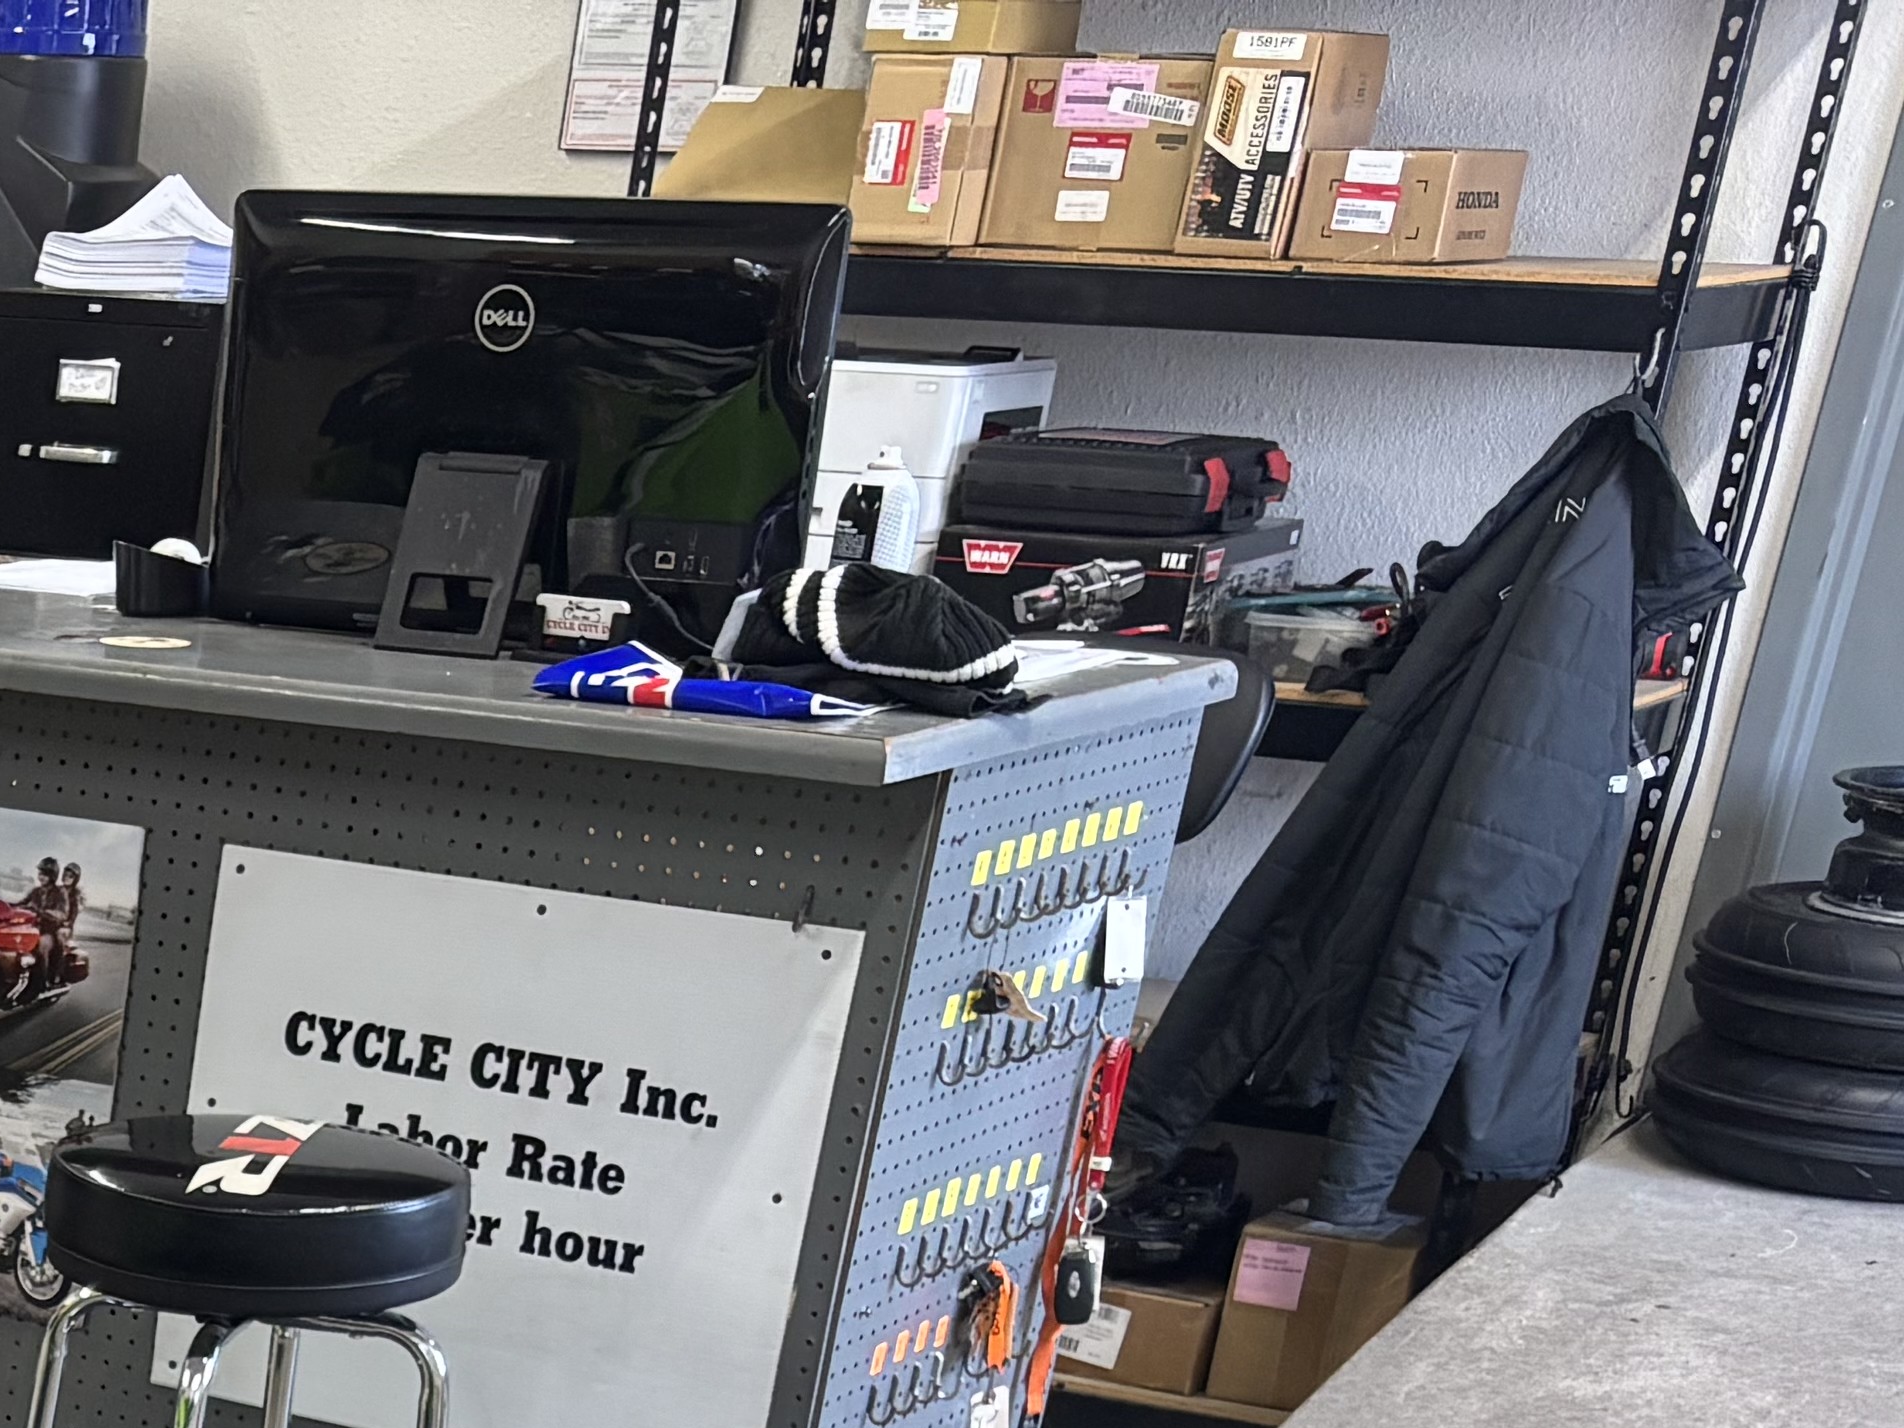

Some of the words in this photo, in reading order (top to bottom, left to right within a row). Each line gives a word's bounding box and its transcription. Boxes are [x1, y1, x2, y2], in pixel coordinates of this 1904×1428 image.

[1245, 73, 1278, 166] ACCESSORIES
[1228, 173, 1256, 230] ATV/UTV
[1455, 190, 1500, 210] HONDA
[482, 308, 528, 329] DELL
[969, 551, 1012, 566] WARN
[1160, 552, 1188, 570] VRX
[283, 1010, 452, 1083] CYCLE
[469, 1041, 604, 1107] CITY
[619, 1068, 720, 1129] Inc.
[507, 1134, 627, 1198] Rate
[519, 1207, 645, 1275] hour
